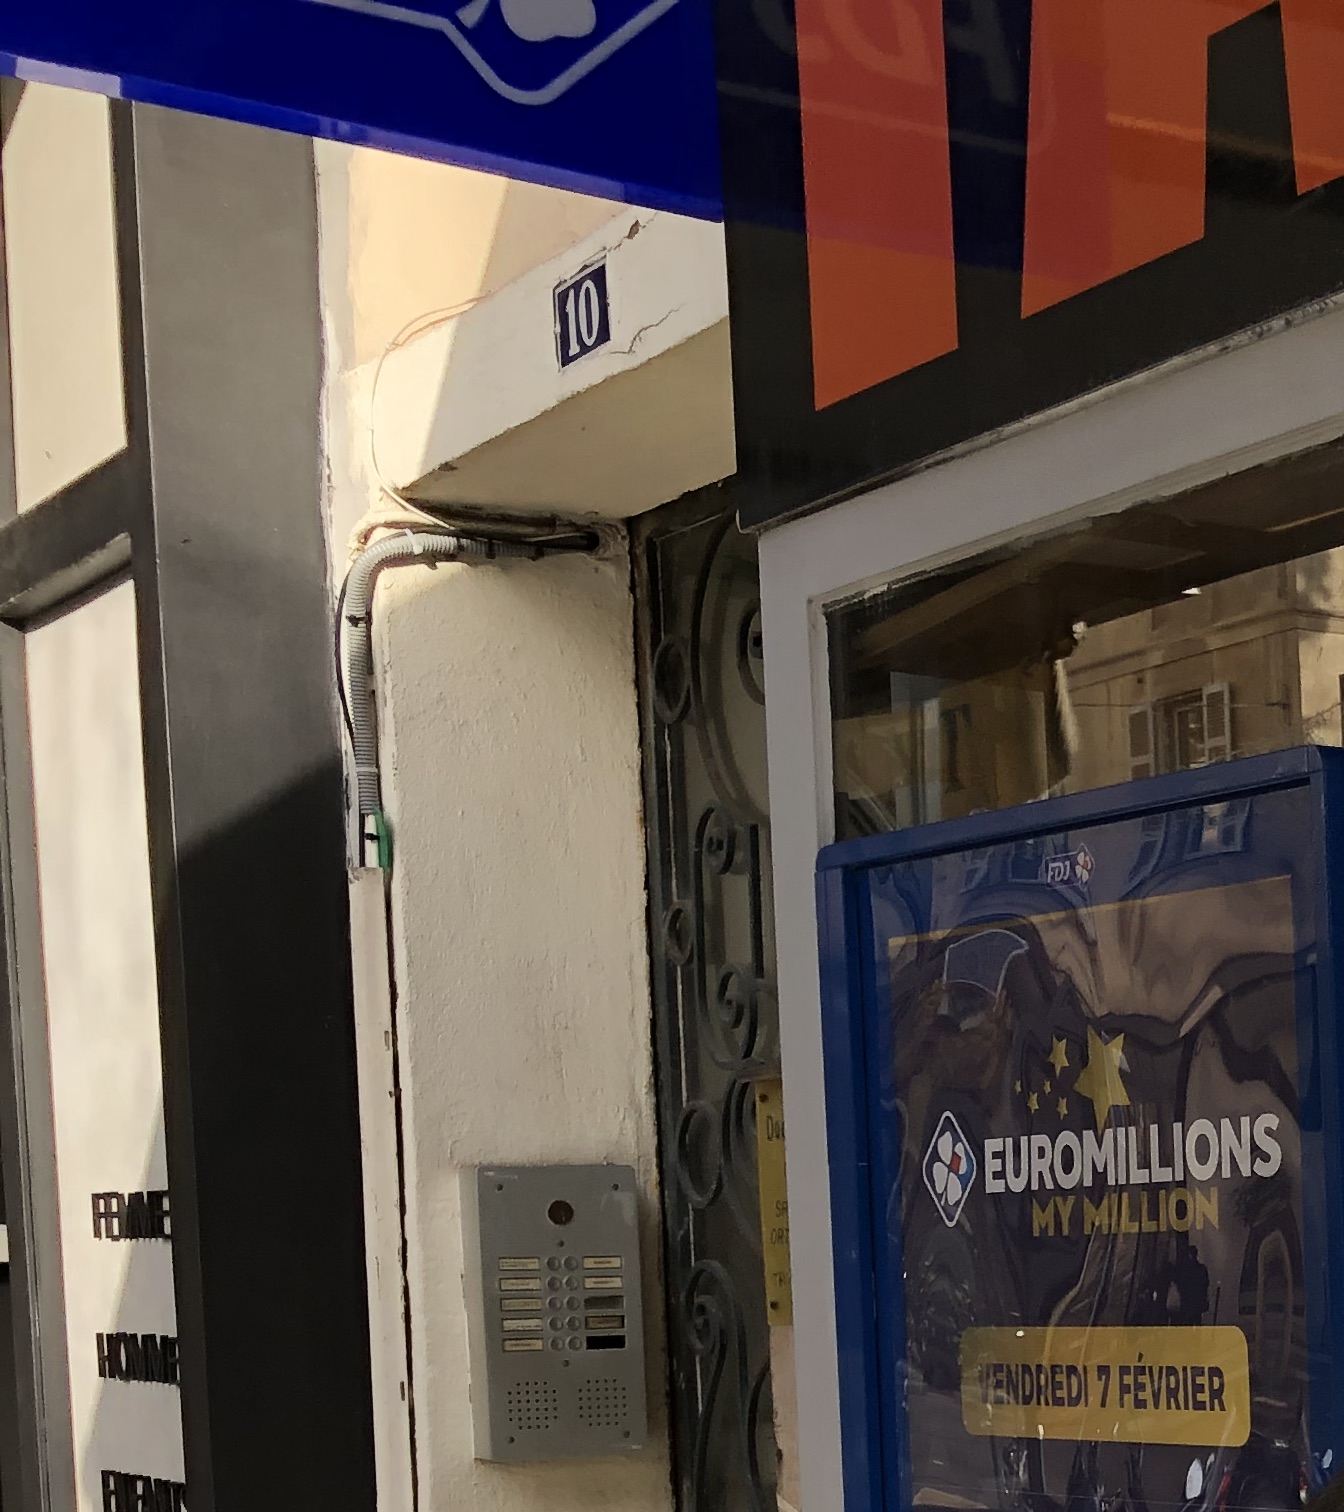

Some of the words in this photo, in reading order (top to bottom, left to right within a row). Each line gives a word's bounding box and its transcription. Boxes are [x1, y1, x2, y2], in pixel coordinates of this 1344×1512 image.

[566, 279, 599, 357] 10
[1048, 860, 1070, 883] FDJ
[985, 1113, 1282, 1195] EUROMILLIONS
[1032, 1195, 1077, 1238] MY
[1084, 1187, 1219, 1236] MILLION
[978, 1362, 1089, 1408] VENDREDI
[1097, 1365, 1111, 1408] 7
[1118, 1352, 1227, 1412] FÉVRIER
